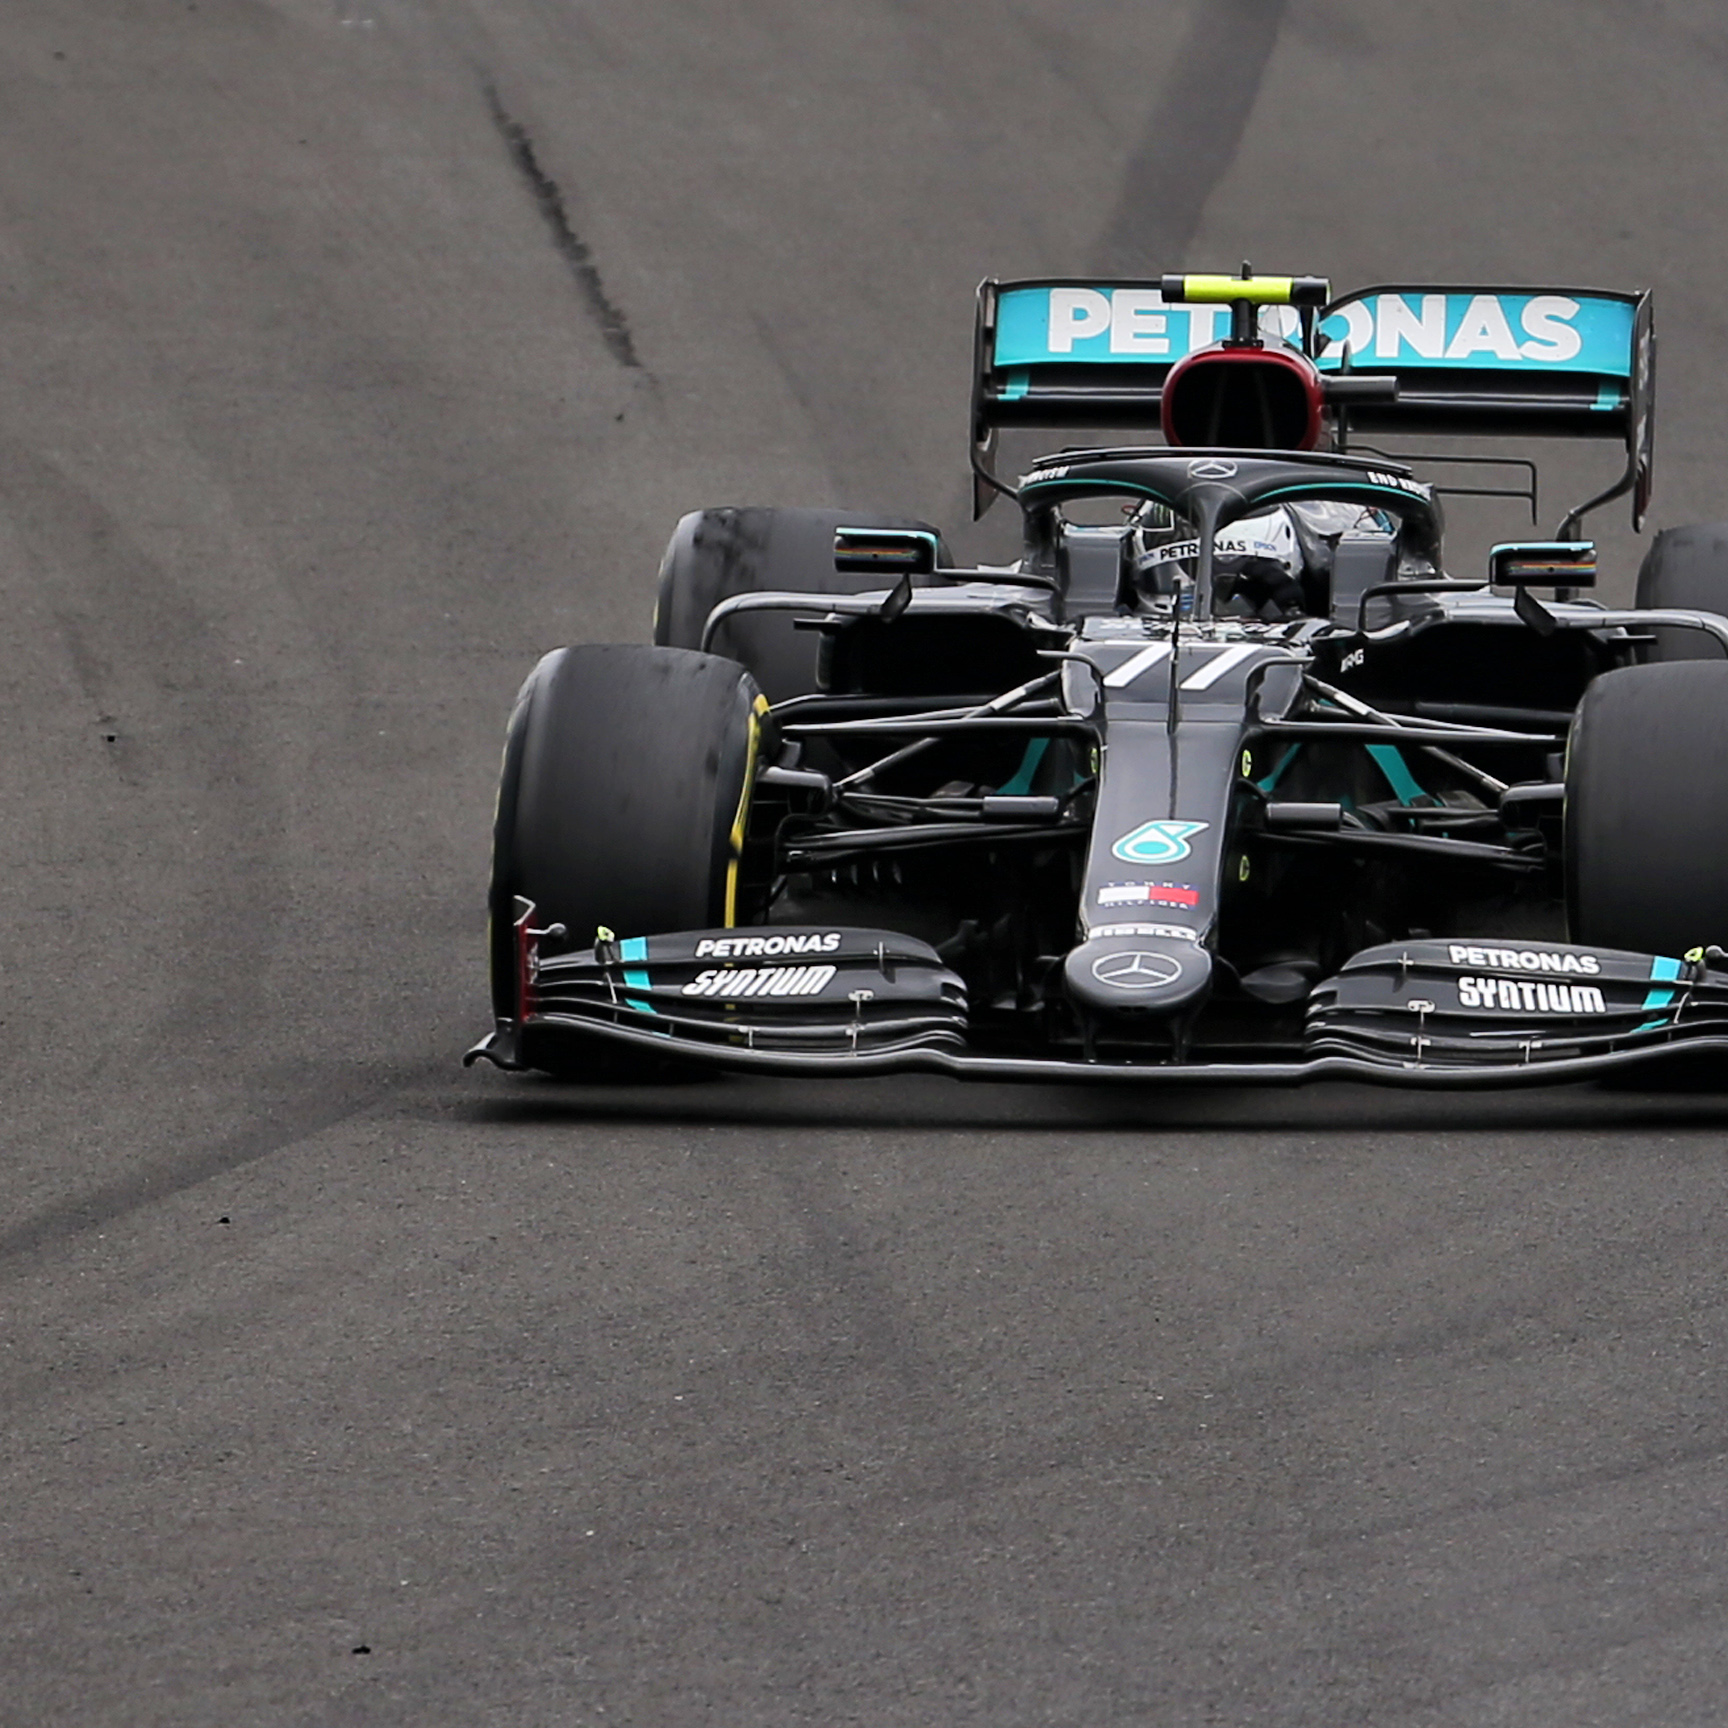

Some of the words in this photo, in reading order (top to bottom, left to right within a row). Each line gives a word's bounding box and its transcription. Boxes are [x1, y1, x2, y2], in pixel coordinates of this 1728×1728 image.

[1160, 541, 1246, 561] PETRNAS
[1102, 639, 1263, 691] 77
[1108, 881, 1191, 890] TOMMY
[694, 932, 841, 958] PETRONAS
[1448, 944, 1600, 974] PETRONAS
[681, 965, 838, 998] SYNTIUM
[1458, 976, 1607, 1014] SYNTIUM
